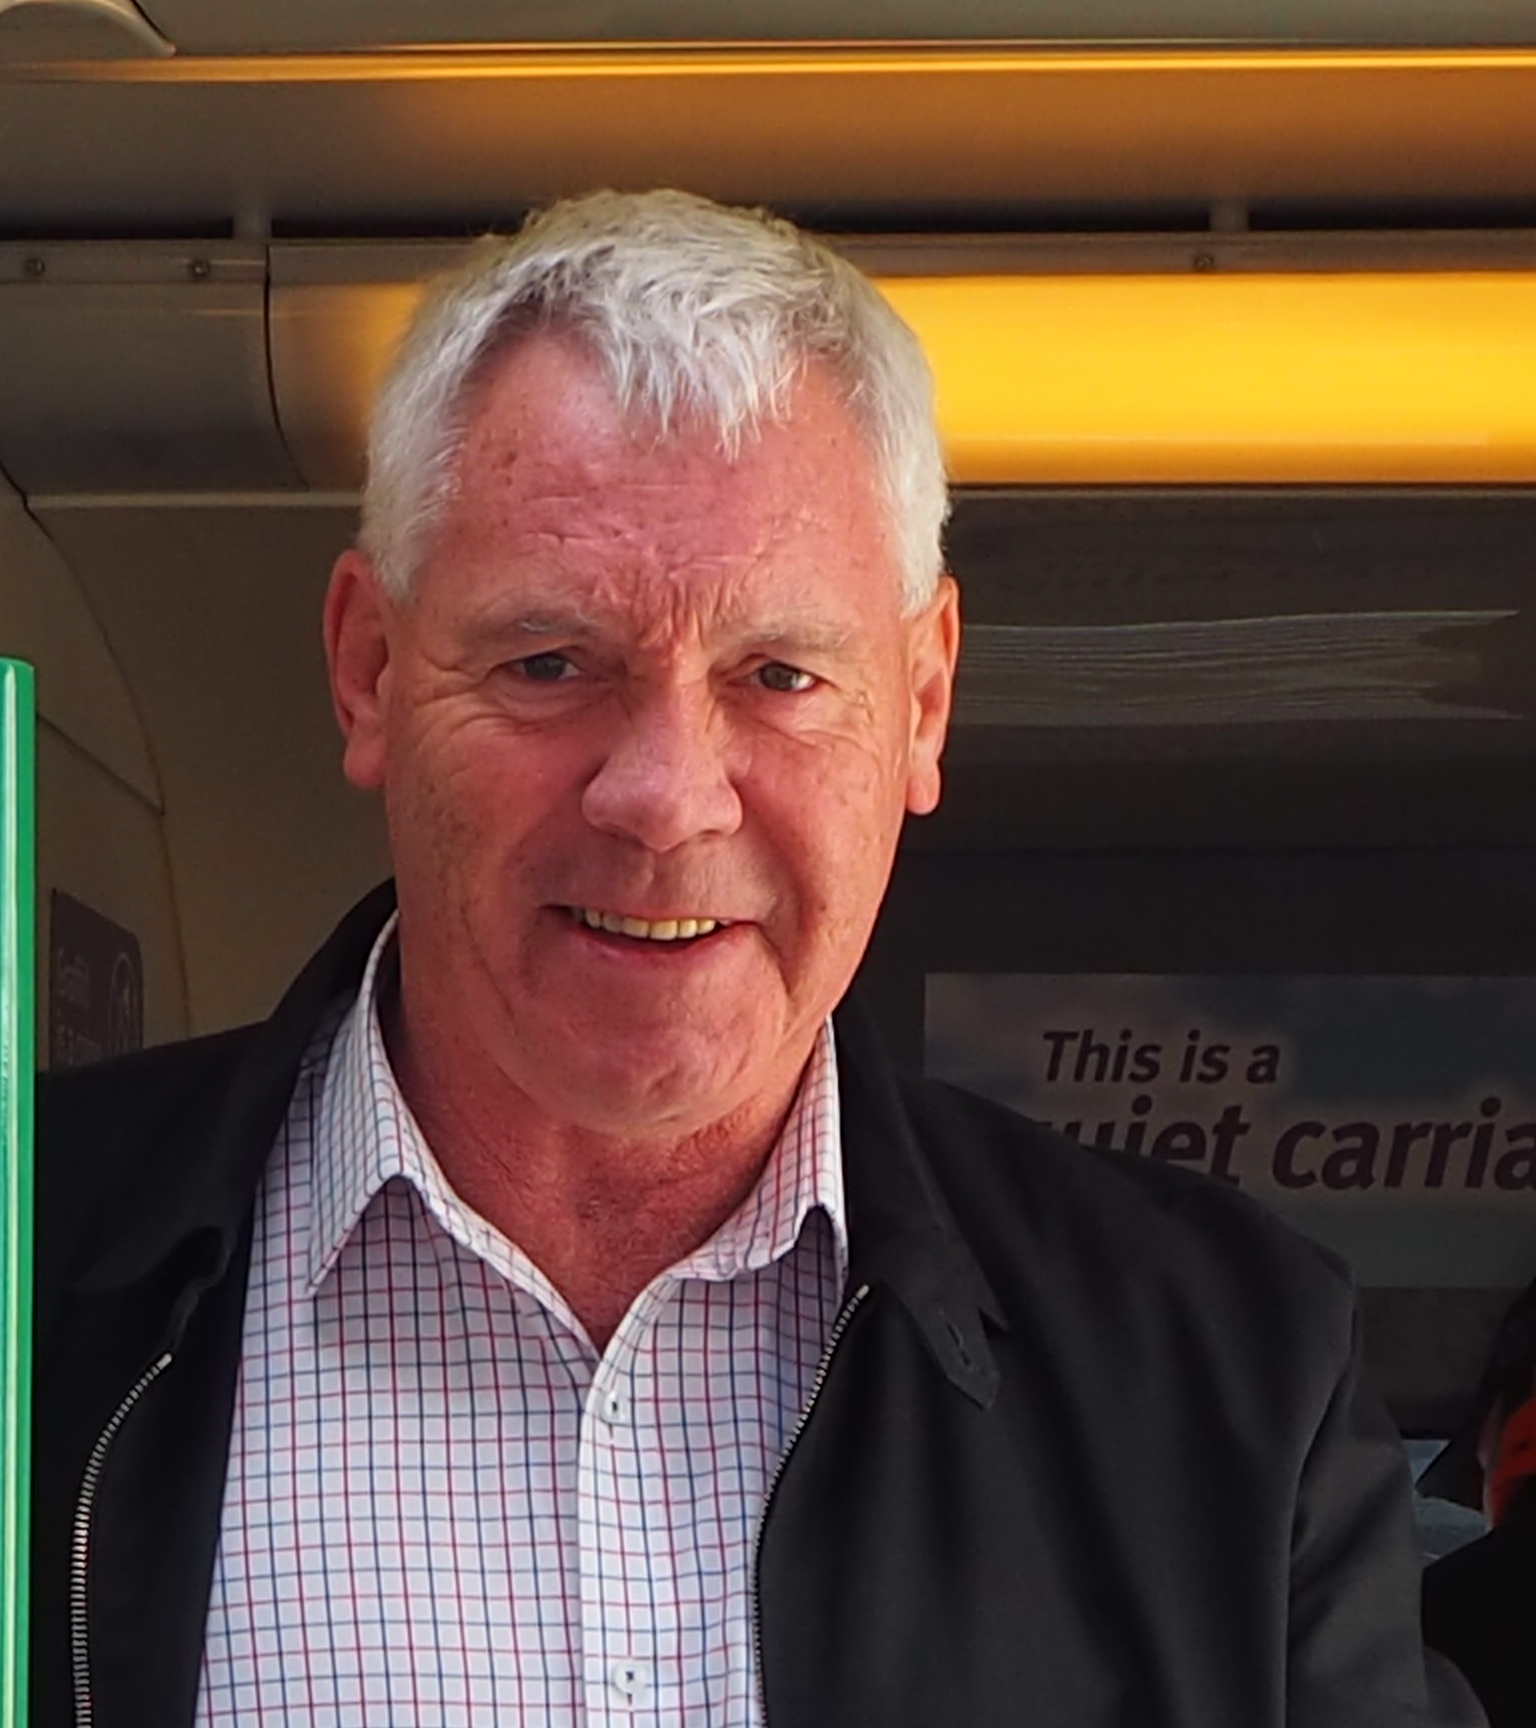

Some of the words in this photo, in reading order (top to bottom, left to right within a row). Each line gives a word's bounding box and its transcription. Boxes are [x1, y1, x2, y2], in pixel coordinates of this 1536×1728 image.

[1043, 1029, 1162, 1083] This
[1179, 1029, 1231, 1083] is
[1246, 1044, 1280, 1084] a
[1036, 1094, 1252, 1186] iet
